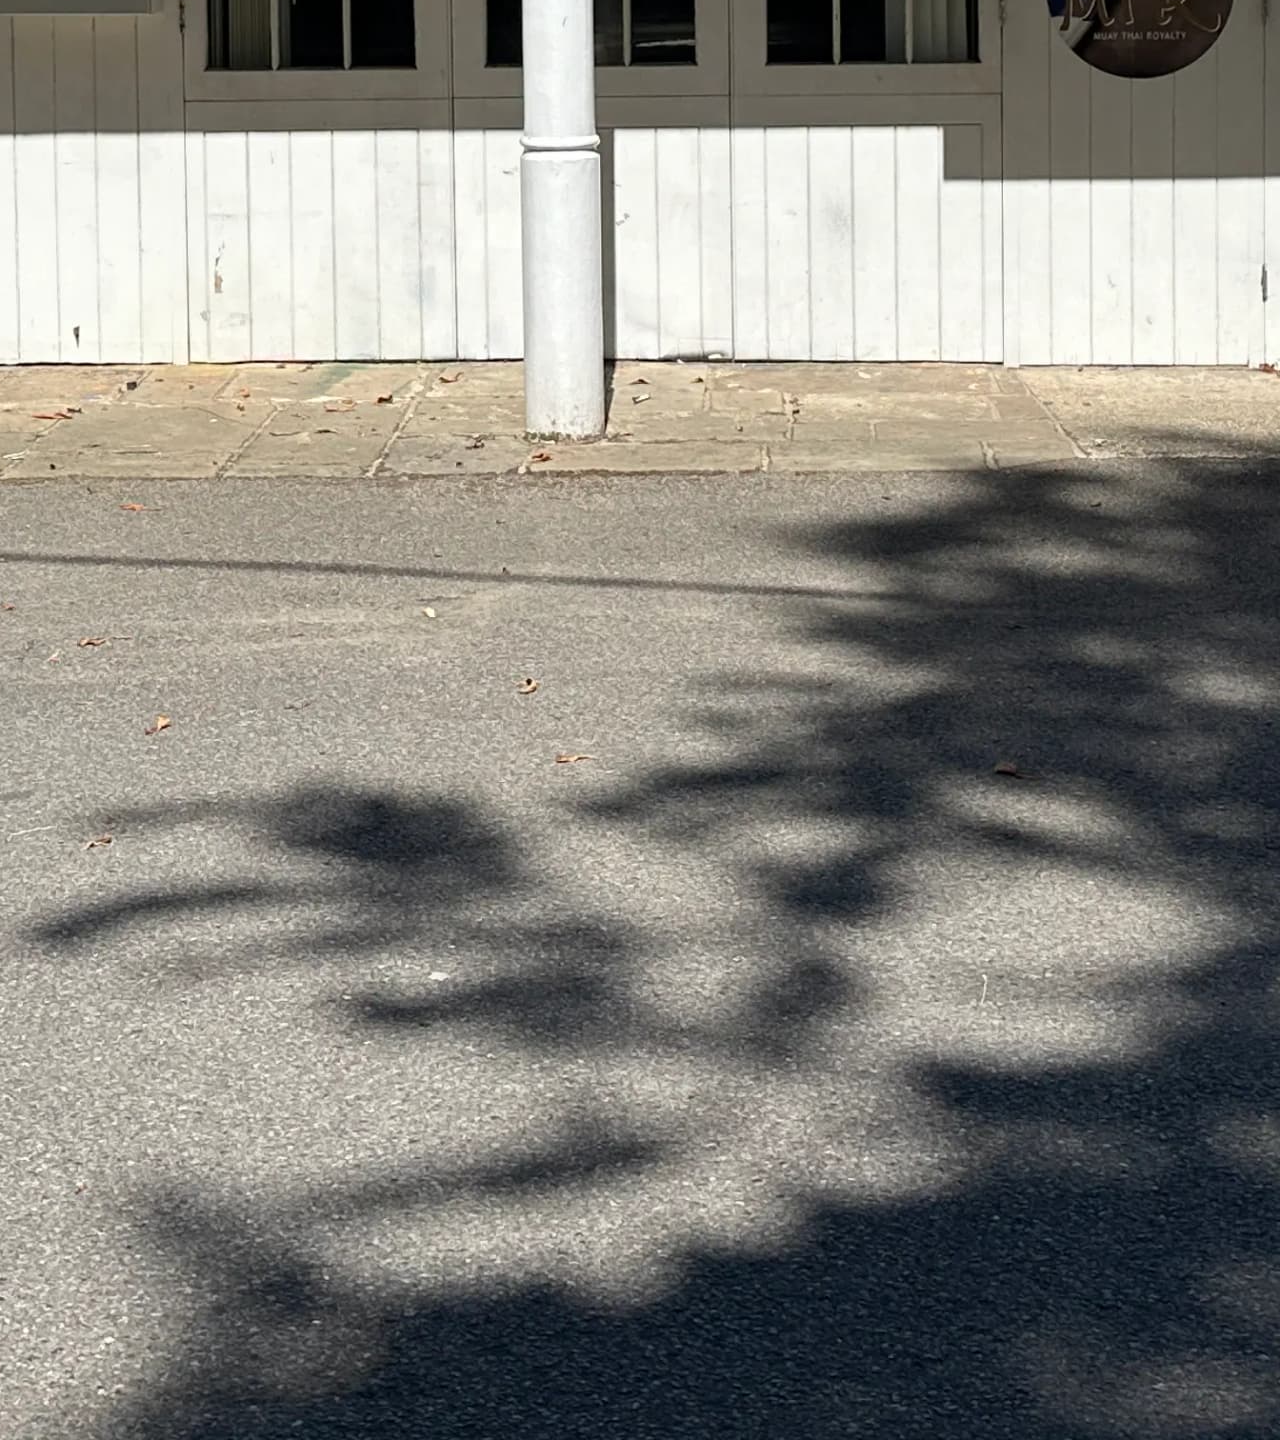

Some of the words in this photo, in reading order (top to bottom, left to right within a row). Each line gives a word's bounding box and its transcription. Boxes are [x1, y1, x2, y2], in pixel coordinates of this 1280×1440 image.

[1093, 31, 1118, 41] MUAY
[1122, 31, 1143, 41] THAI
[1147, 31, 1187, 41] ROYALTY
